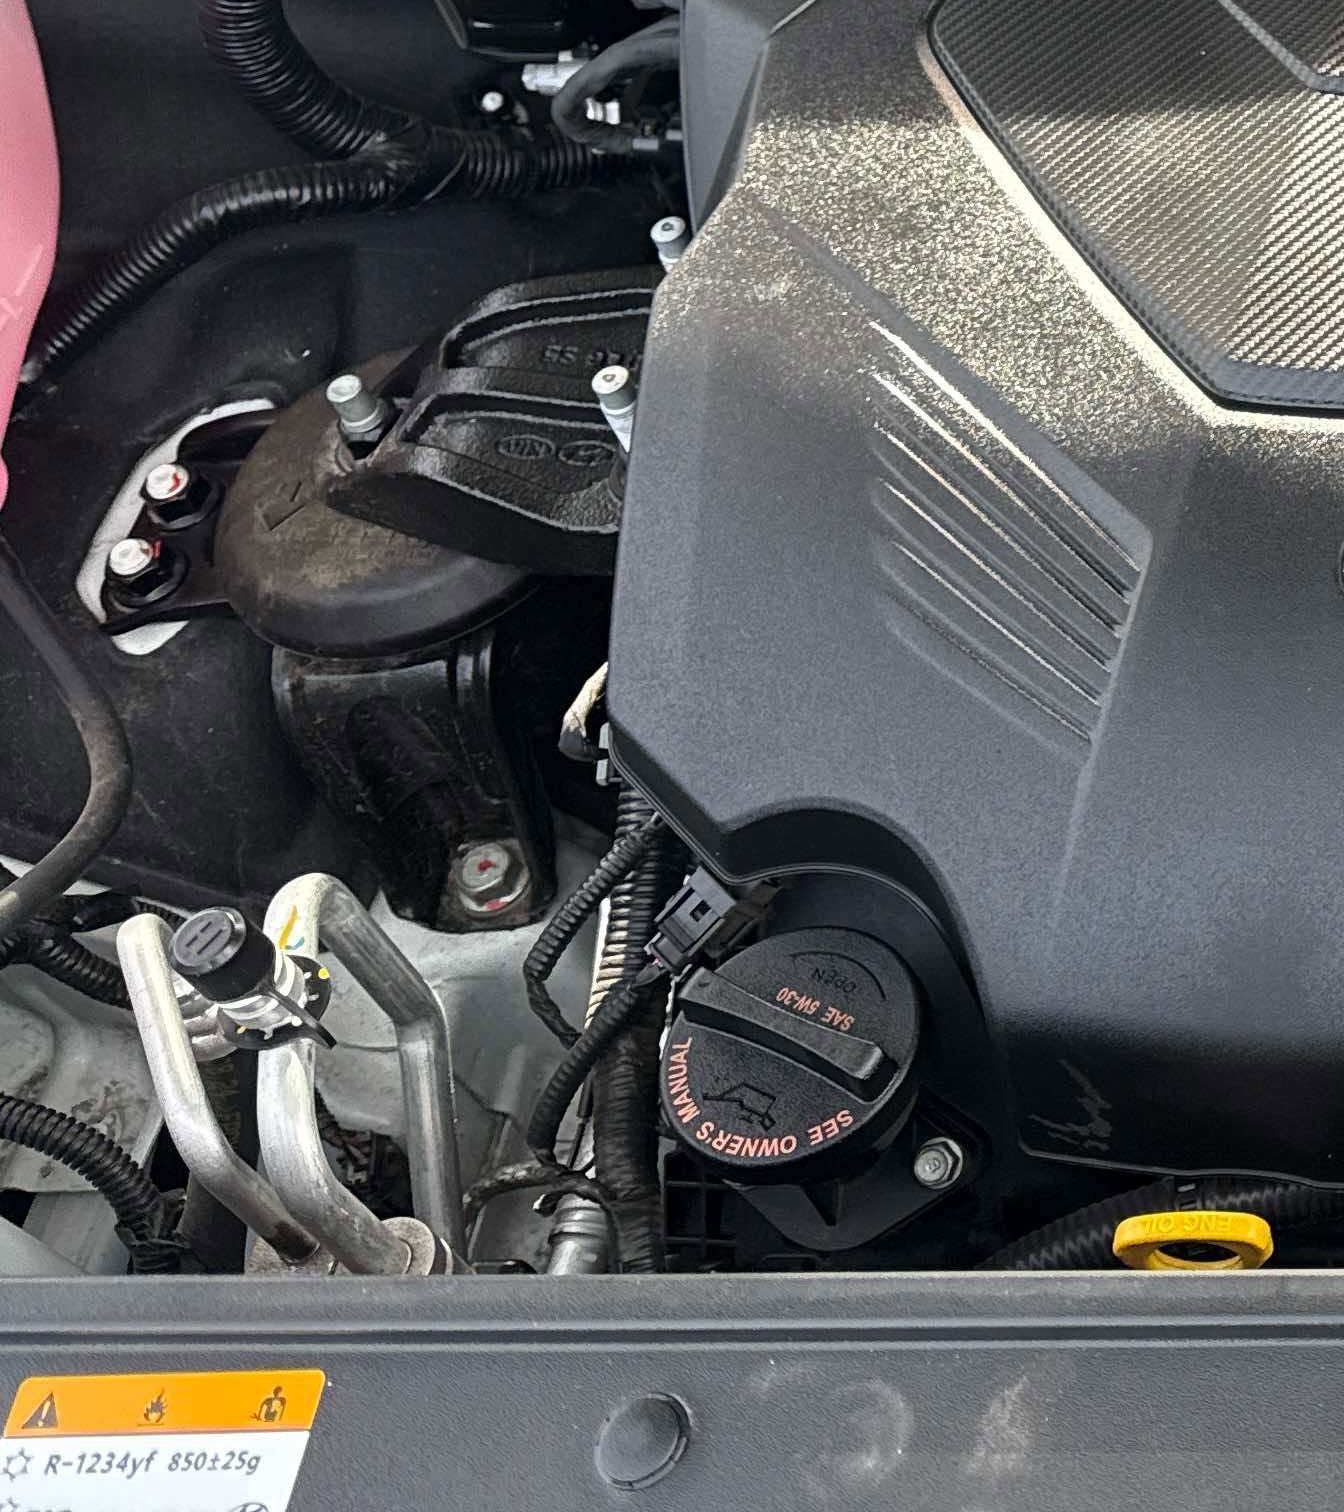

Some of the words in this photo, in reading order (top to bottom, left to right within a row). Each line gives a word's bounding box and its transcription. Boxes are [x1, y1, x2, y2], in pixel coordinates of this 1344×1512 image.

[811, 967, 857, 994] OPEN
[775, 987, 821, 1016] 5W-30
[820, 1006, 855, 1032] SAE
[667, 1037, 701, 1124] MANUAL
[695, 1120, 798, 1158] OWNER'S
[807, 1109, 854, 1146] SEE
[1144, 1215, 1176, 1234] OIL
[1183, 1214, 1233, 1232] ENG
[44, 1449, 159, 1480] R-1234yf
[167, 1450, 262, 1475] 850±25g
